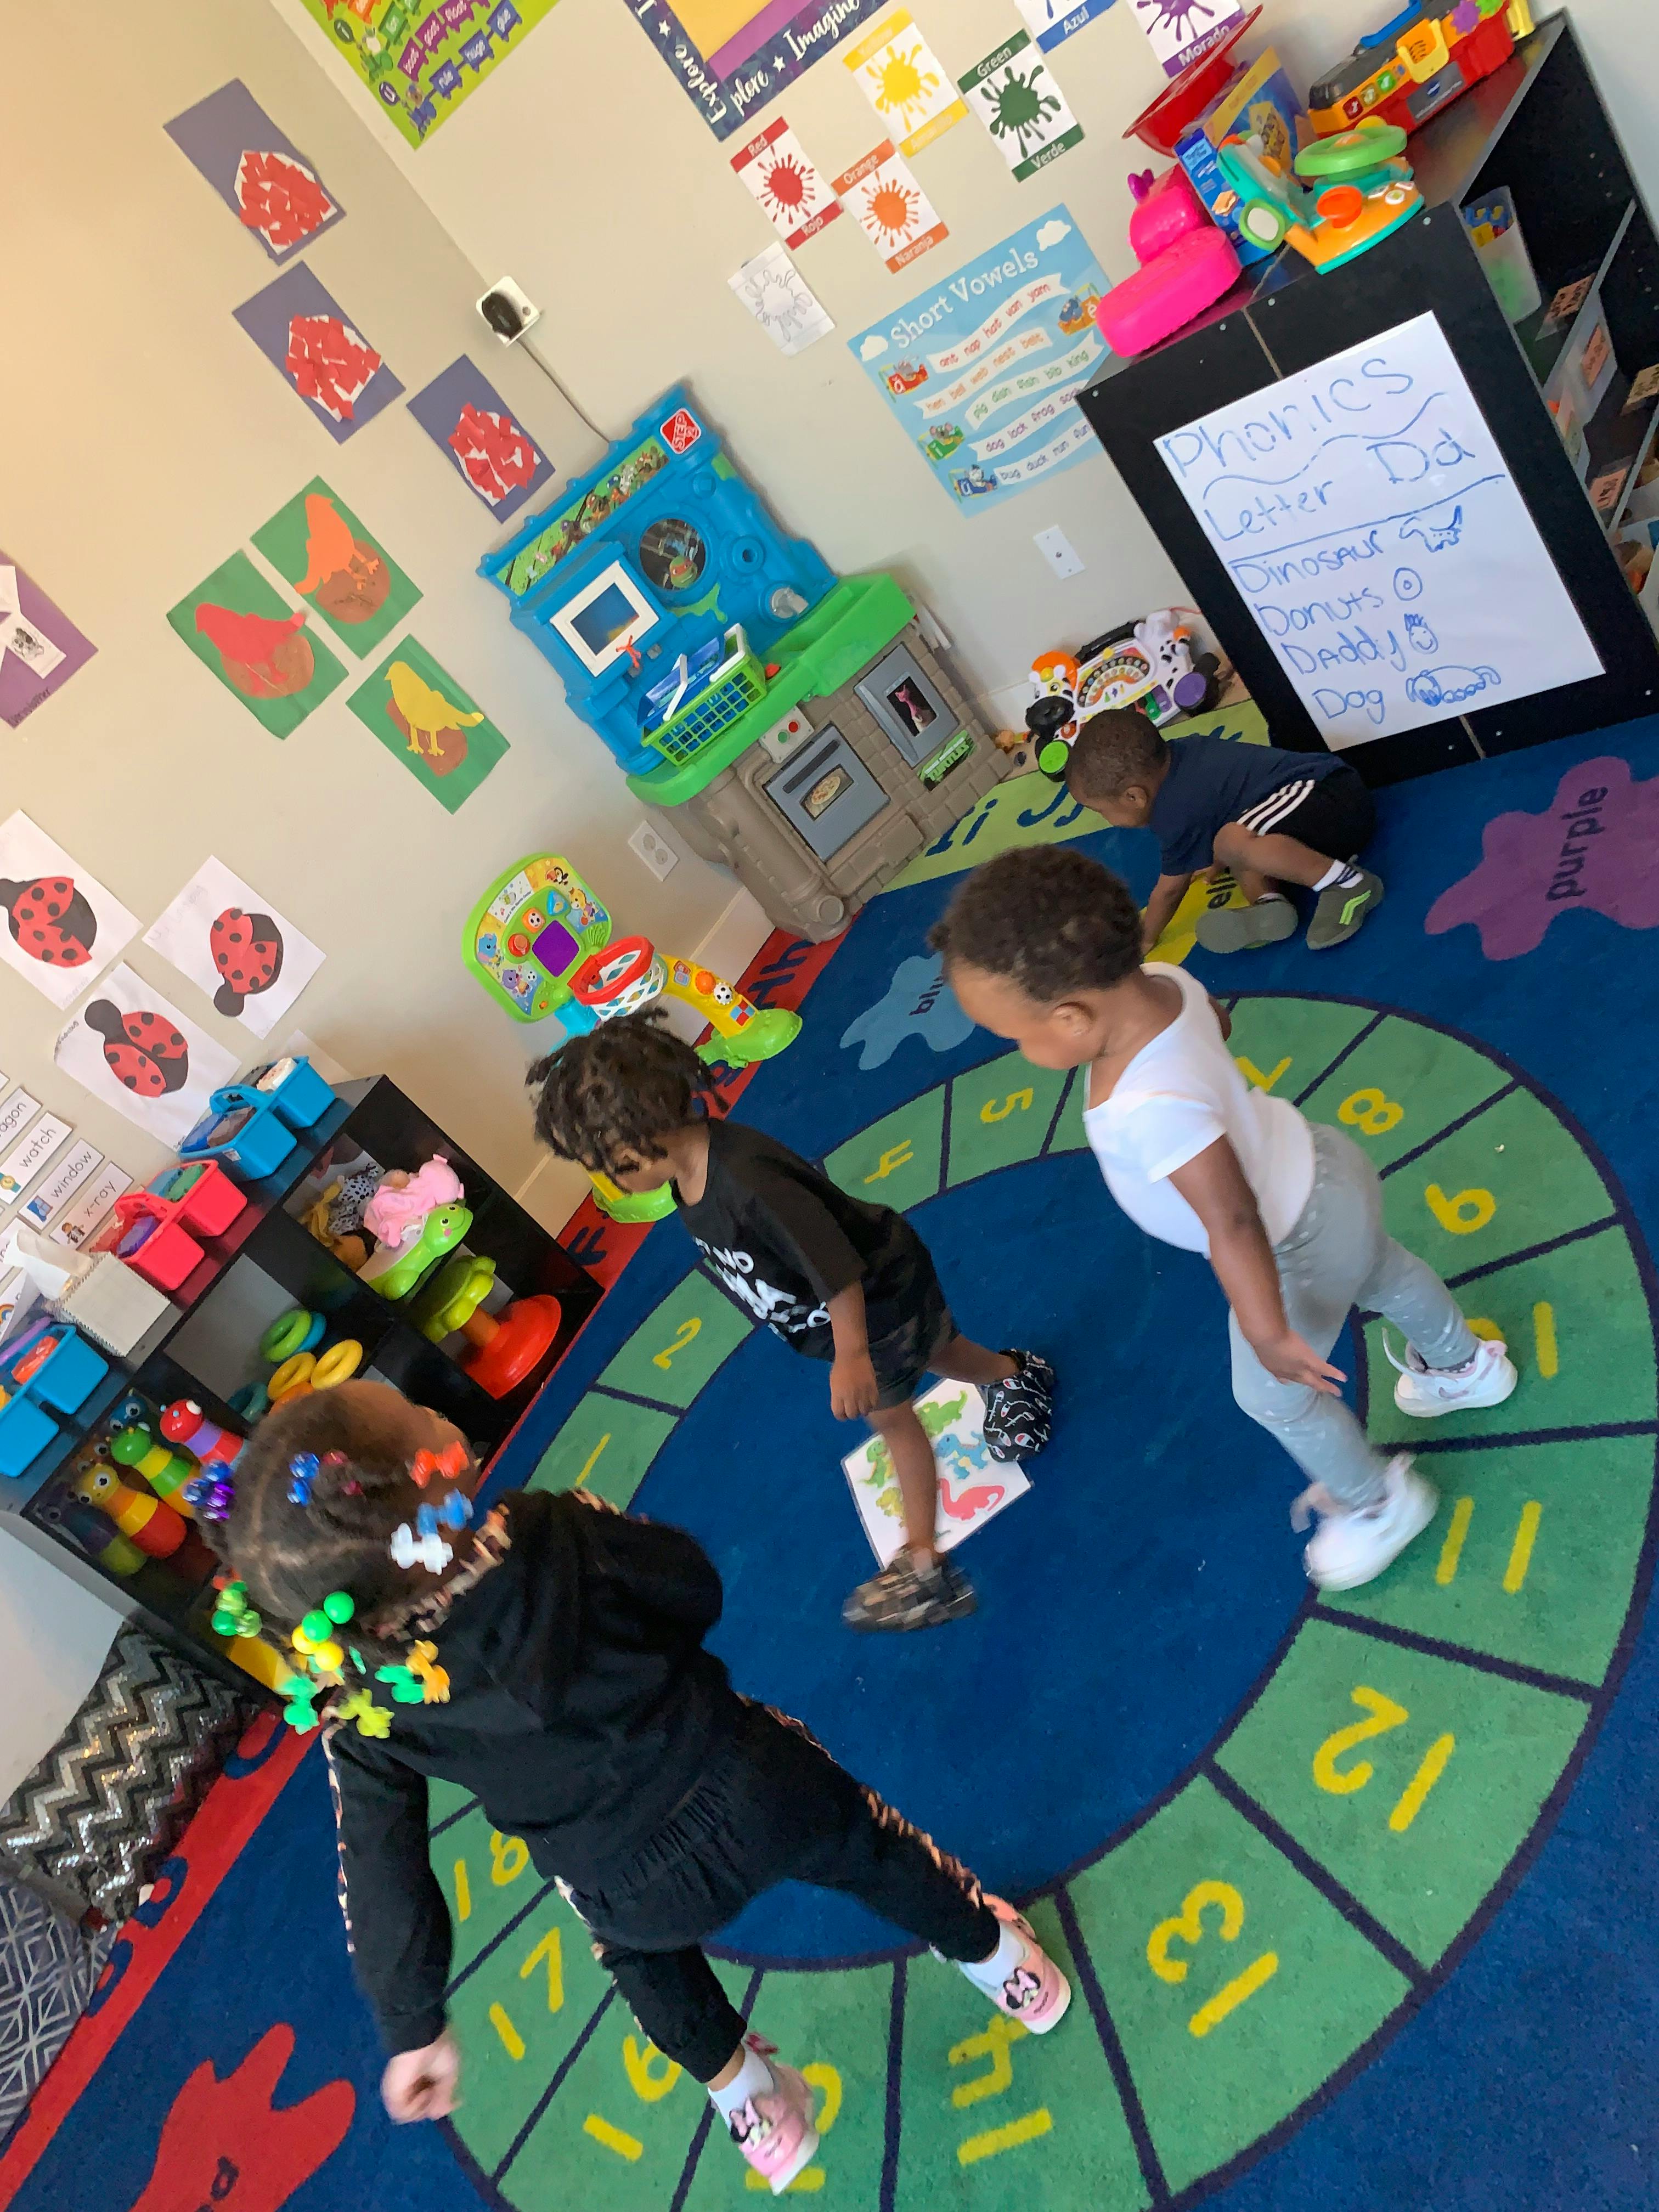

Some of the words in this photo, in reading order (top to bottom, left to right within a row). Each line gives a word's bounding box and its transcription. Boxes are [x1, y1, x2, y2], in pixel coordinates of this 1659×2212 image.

[1063, 6, 1090, 34] Azul
[675, 43, 726, 123] Explore
[977, 47, 1012, 77] Green
[730, 71, 769, 116] plore
[748, 135, 768, 157] Red
[1031, 142, 1066, 167] Verde
[843, 154, 879, 185] Orange
[801, 216, 823, 236] Rojo
[895, 236, 934, 267] Naranja
[891, 296, 953, 348] Short
[949, 249, 1039, 302] Vowels
[964, 339, 980, 356] nap
[983, 318, 1002, 338] hat
[1006, 300, 1023, 317] van
[1027, 284, 1051, 303] yarn
[973, 403, 988, 420] pig
[992, 387, 1012, 403] dish
[1017, 376, 1040, 390] fish
[1043, 366, 1062, 380] bib
[1066, 350, 1089, 368] king
[673, 413, 687, 449] STEP
[685, 426, 699, 441] 2
[986, 439, 1005, 453] dog
[1007, 423, 1028, 439] lock
[1031, 404, 1055, 422] frog
[1000, 469, 1022, 481] bug
[1026, 454, 1049, 472] duck
[1053, 441, 1069, 456] run
[1203, 478, 1333, 541] Letter
[1366, 427, 1476, 484] Dd
[1253, 587, 1384, 637] Donuts
[1312, 688, 1386, 725] Dog
[1546, 786, 1609, 901] purple
[1234, 1056, 1293, 1093] 7
[0, 1102, 27, 1136] agon
[980, 1088, 1033, 1123] 5
[1338, 1088, 1403, 1135] 8
[19, 1127, 57, 1167] watch
[865, 1139, 913, 1184] 4
[51, 1152, 92, 1198] window
[84, 1181, 116, 1217] x-ray
[653, 1317, 702, 1369] 2
[576, 1432, 611, 1485] 1
[1435, 1496, 1542, 1594] 11
[1313, 1685, 1455, 1832] 12
[1146, 1881, 1278, 2037] 13
[489, 1927, 564, 2060] 17
